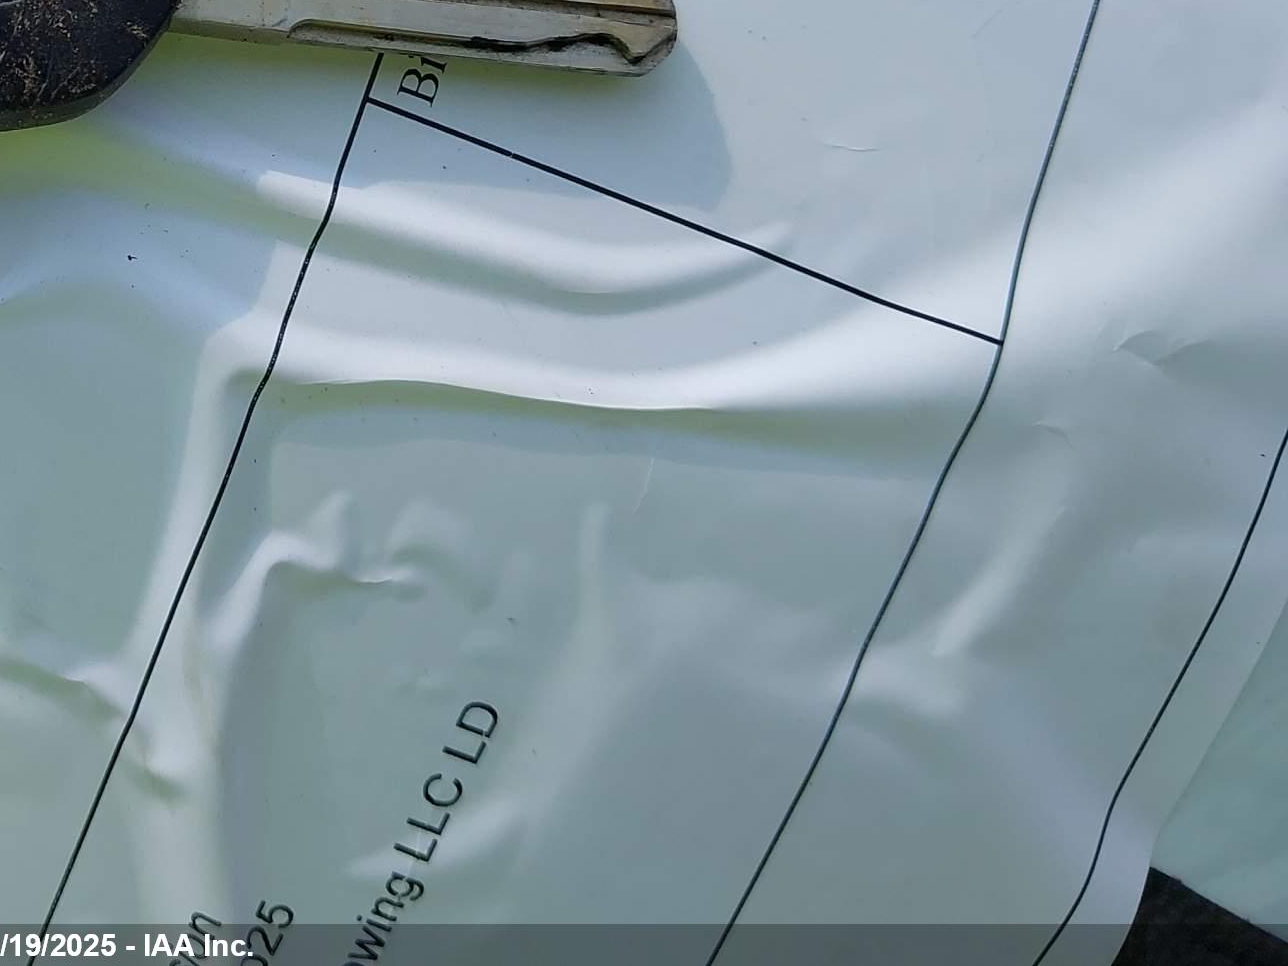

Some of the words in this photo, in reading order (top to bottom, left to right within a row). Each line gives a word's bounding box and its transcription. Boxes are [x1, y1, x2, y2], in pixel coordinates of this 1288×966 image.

[340, 871, 425, 966] wing
[393, 773, 463, 863] LLC
[442, 701, 499, 764] LD
